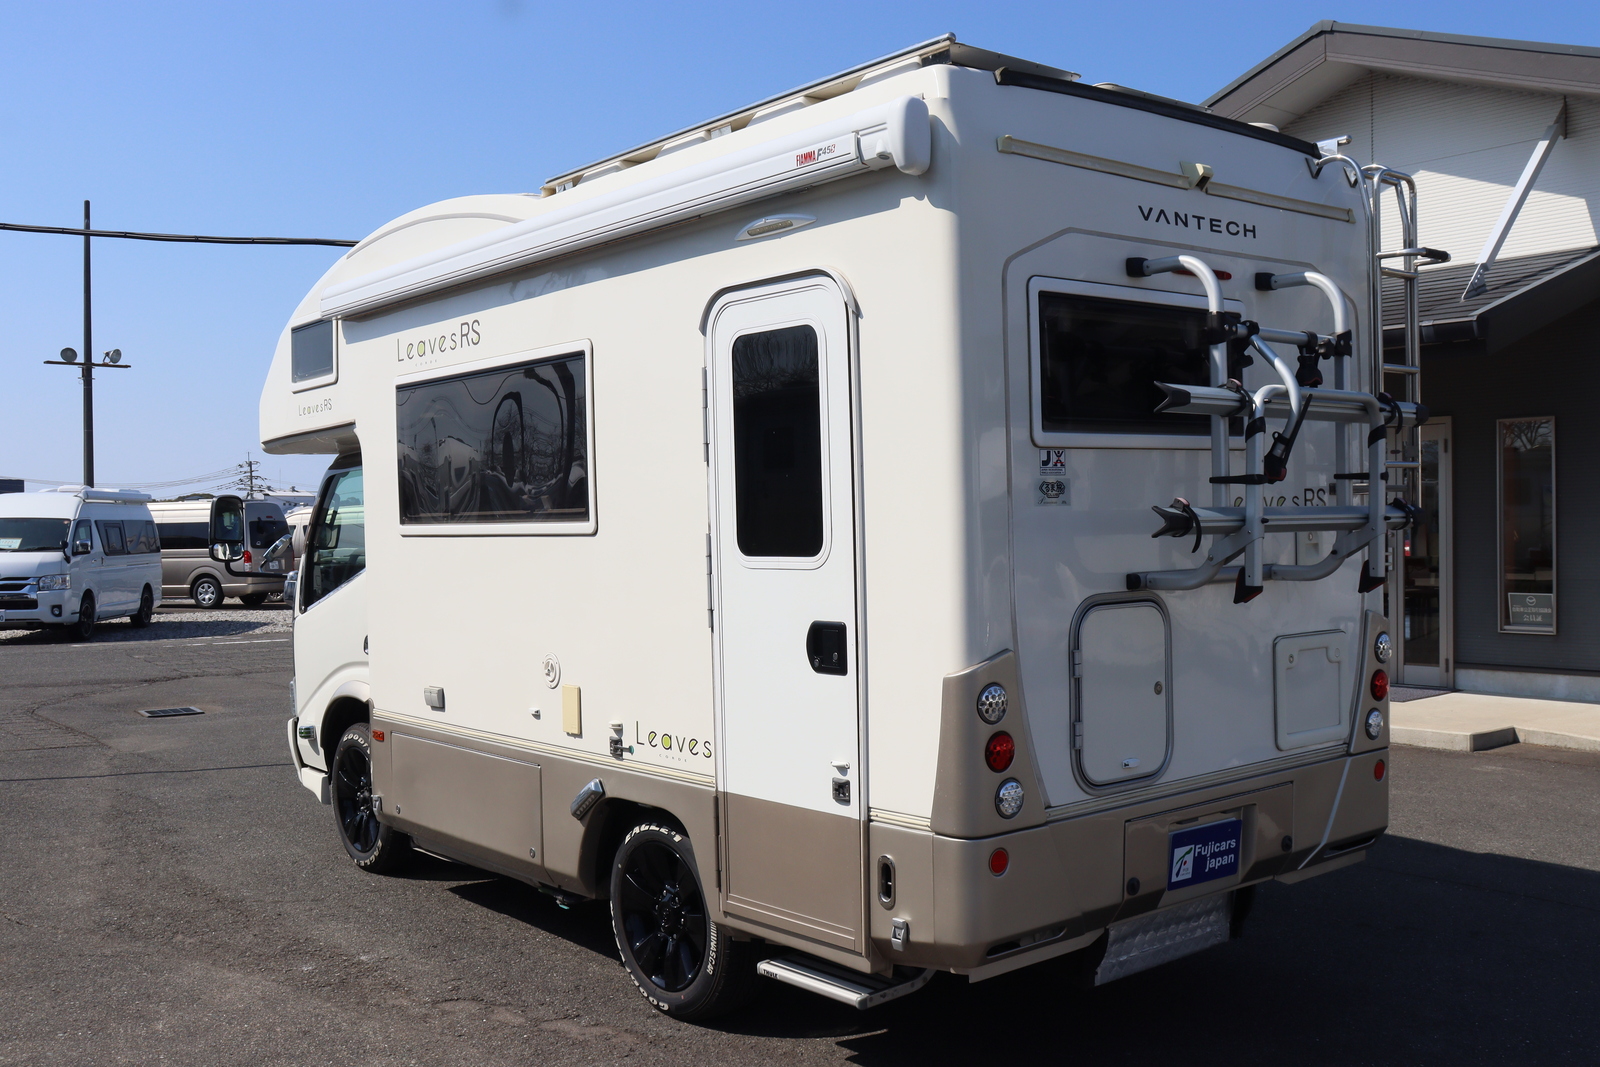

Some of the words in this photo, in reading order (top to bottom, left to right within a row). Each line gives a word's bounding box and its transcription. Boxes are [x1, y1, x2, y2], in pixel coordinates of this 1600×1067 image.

[796, 150, 817, 167] FIAMMA
[1138, 205, 1256, 239] VANTECH
[636, 720, 713, 759] Leaves
[1195, 839, 1237, 858] Fujicars
[1205, 854, 1235, 873] japan
